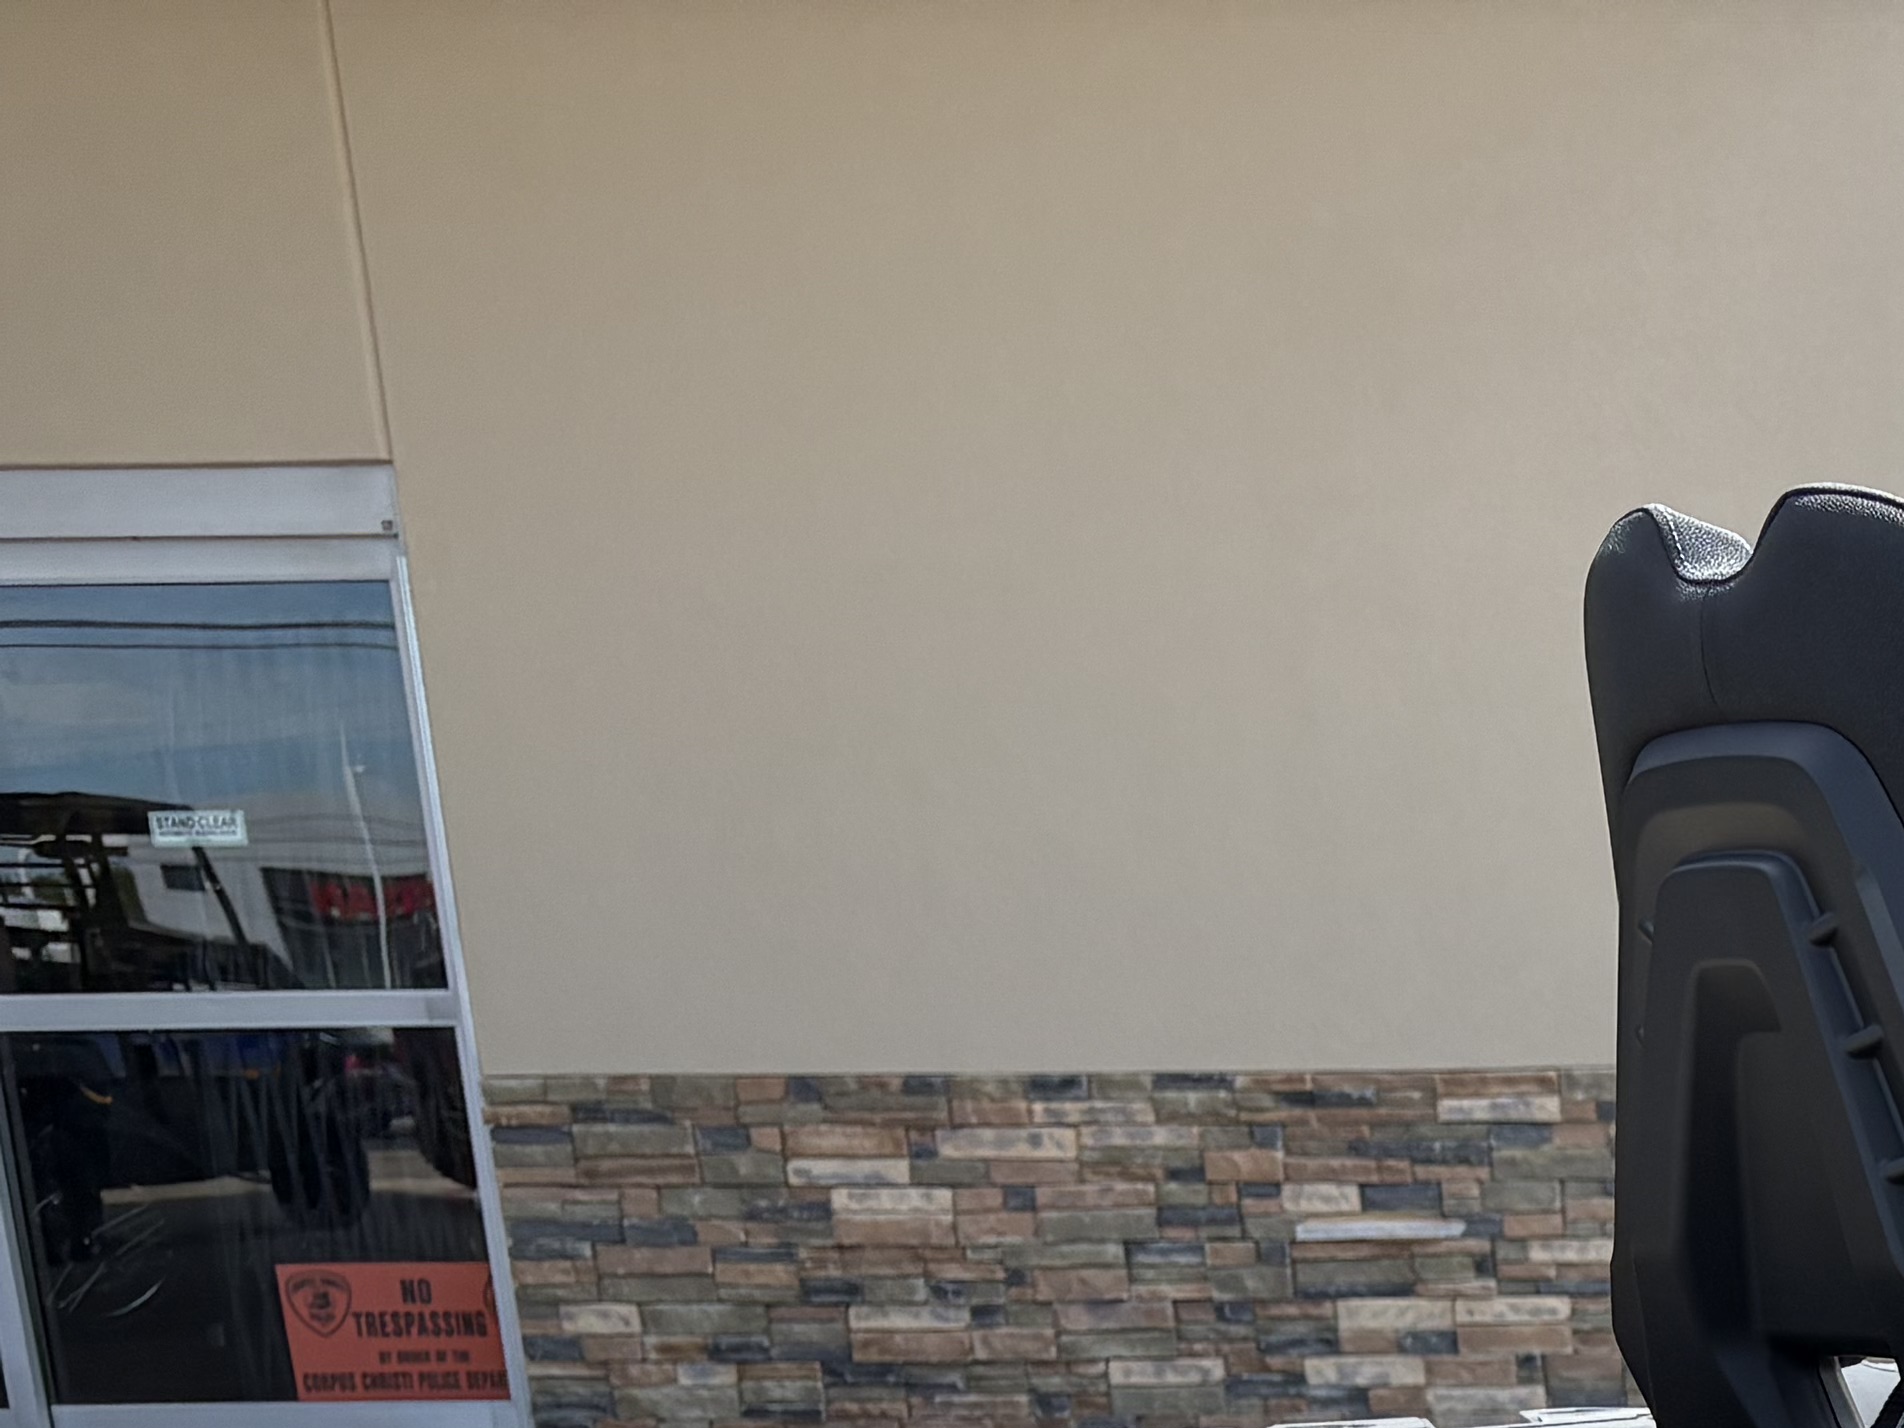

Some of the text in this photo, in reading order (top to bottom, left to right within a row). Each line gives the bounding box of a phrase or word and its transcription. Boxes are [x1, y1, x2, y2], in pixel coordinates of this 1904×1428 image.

[400, 1279, 433, 1305] NO
[352, 1311, 488, 1338] TRESPASSING
[303, 1372, 357, 1393] CORPUS
[362, 1371, 414, 1391] CHRISTI
[418, 1371, 462, 1390] POLICE
